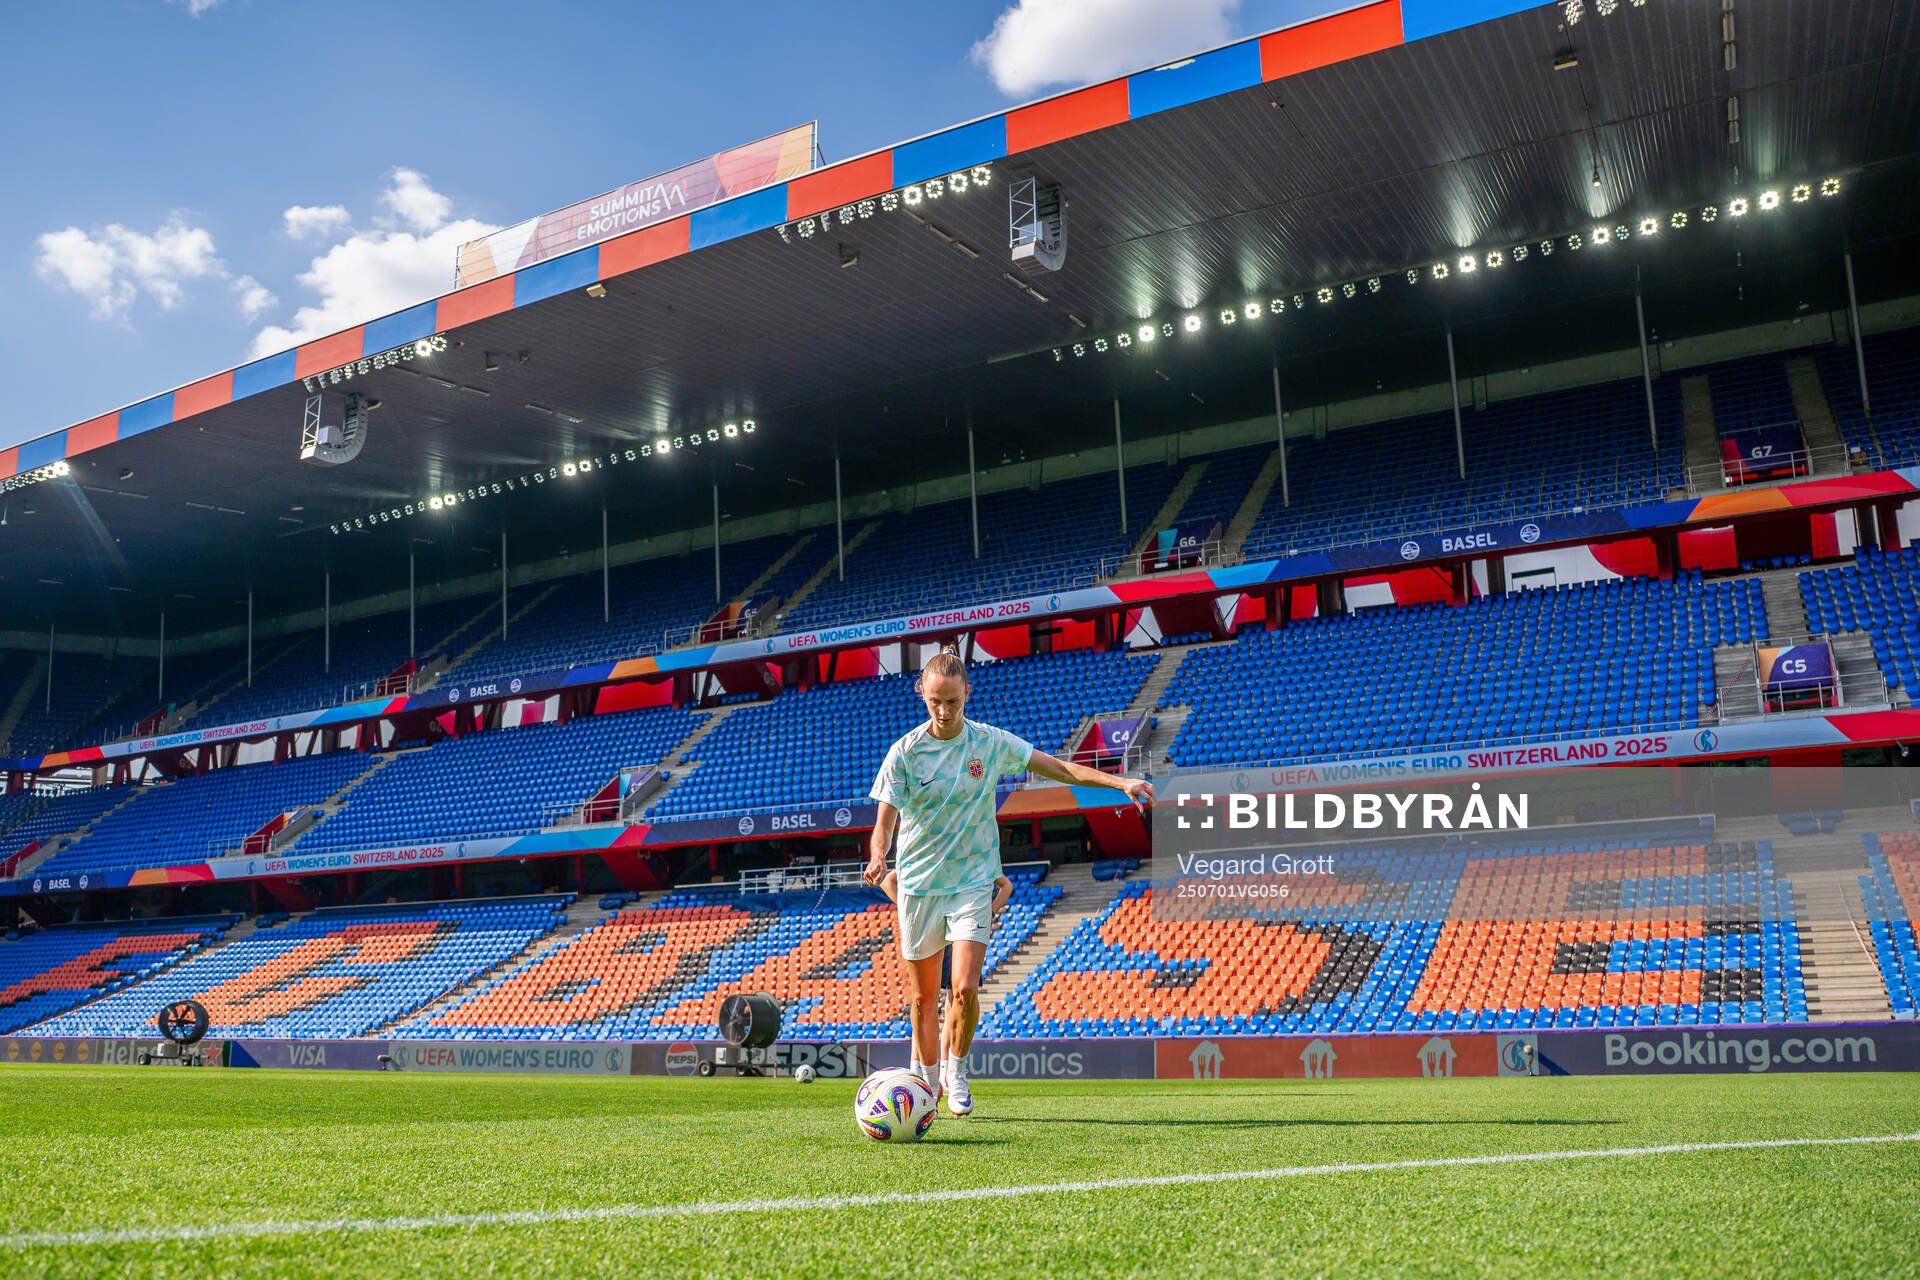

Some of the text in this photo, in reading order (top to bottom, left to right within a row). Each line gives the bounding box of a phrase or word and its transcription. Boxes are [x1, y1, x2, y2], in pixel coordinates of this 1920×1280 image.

[590, 186, 655, 220] SUMMIT
[577, 200, 661, 240] EMOTIONS
[1751, 445, 1772, 459] G7
[1180, 536, 1196, 547] G6
[1442, 533, 1497, 552] BASEL
[788, 601, 1031, 648] UEFA WOMEN'S EURO SWITZERLAND 2025
[1782, 659, 1807, 674] C5
[470, 684, 499, 697] BASEL
[139, 741, 155, 750] UEFA
[156, 735, 184, 748] WOMEN'S
[185, 733, 201, 743] EURO
[202, 725, 248, 740] SWITZERLAND
[1112, 730, 1130, 744] C4
[1271, 769, 1319, 786] UEFA
[1322, 759, 1406, 782] WOMEN'S
[1411, 755, 1462, 773] EURO
[1467, 741, 1608, 768] SWITZERLAND
[771, 814, 816, 831] BASEL
[265, 847, 444, 871] UEFA WOMEN'S EURO SWITZERLAND 2025
[48, 878, 71, 890] BASEL
[286, 1045, 326, 1066] VISA
[415, 1047, 593, 1069] UEFA WOMEN'S EURO
[667, 1055, 697, 1064] PEPSI
[966, 1046, 1083, 1076] uronics
[1605, 1031, 1877, 1072] Booking.com
